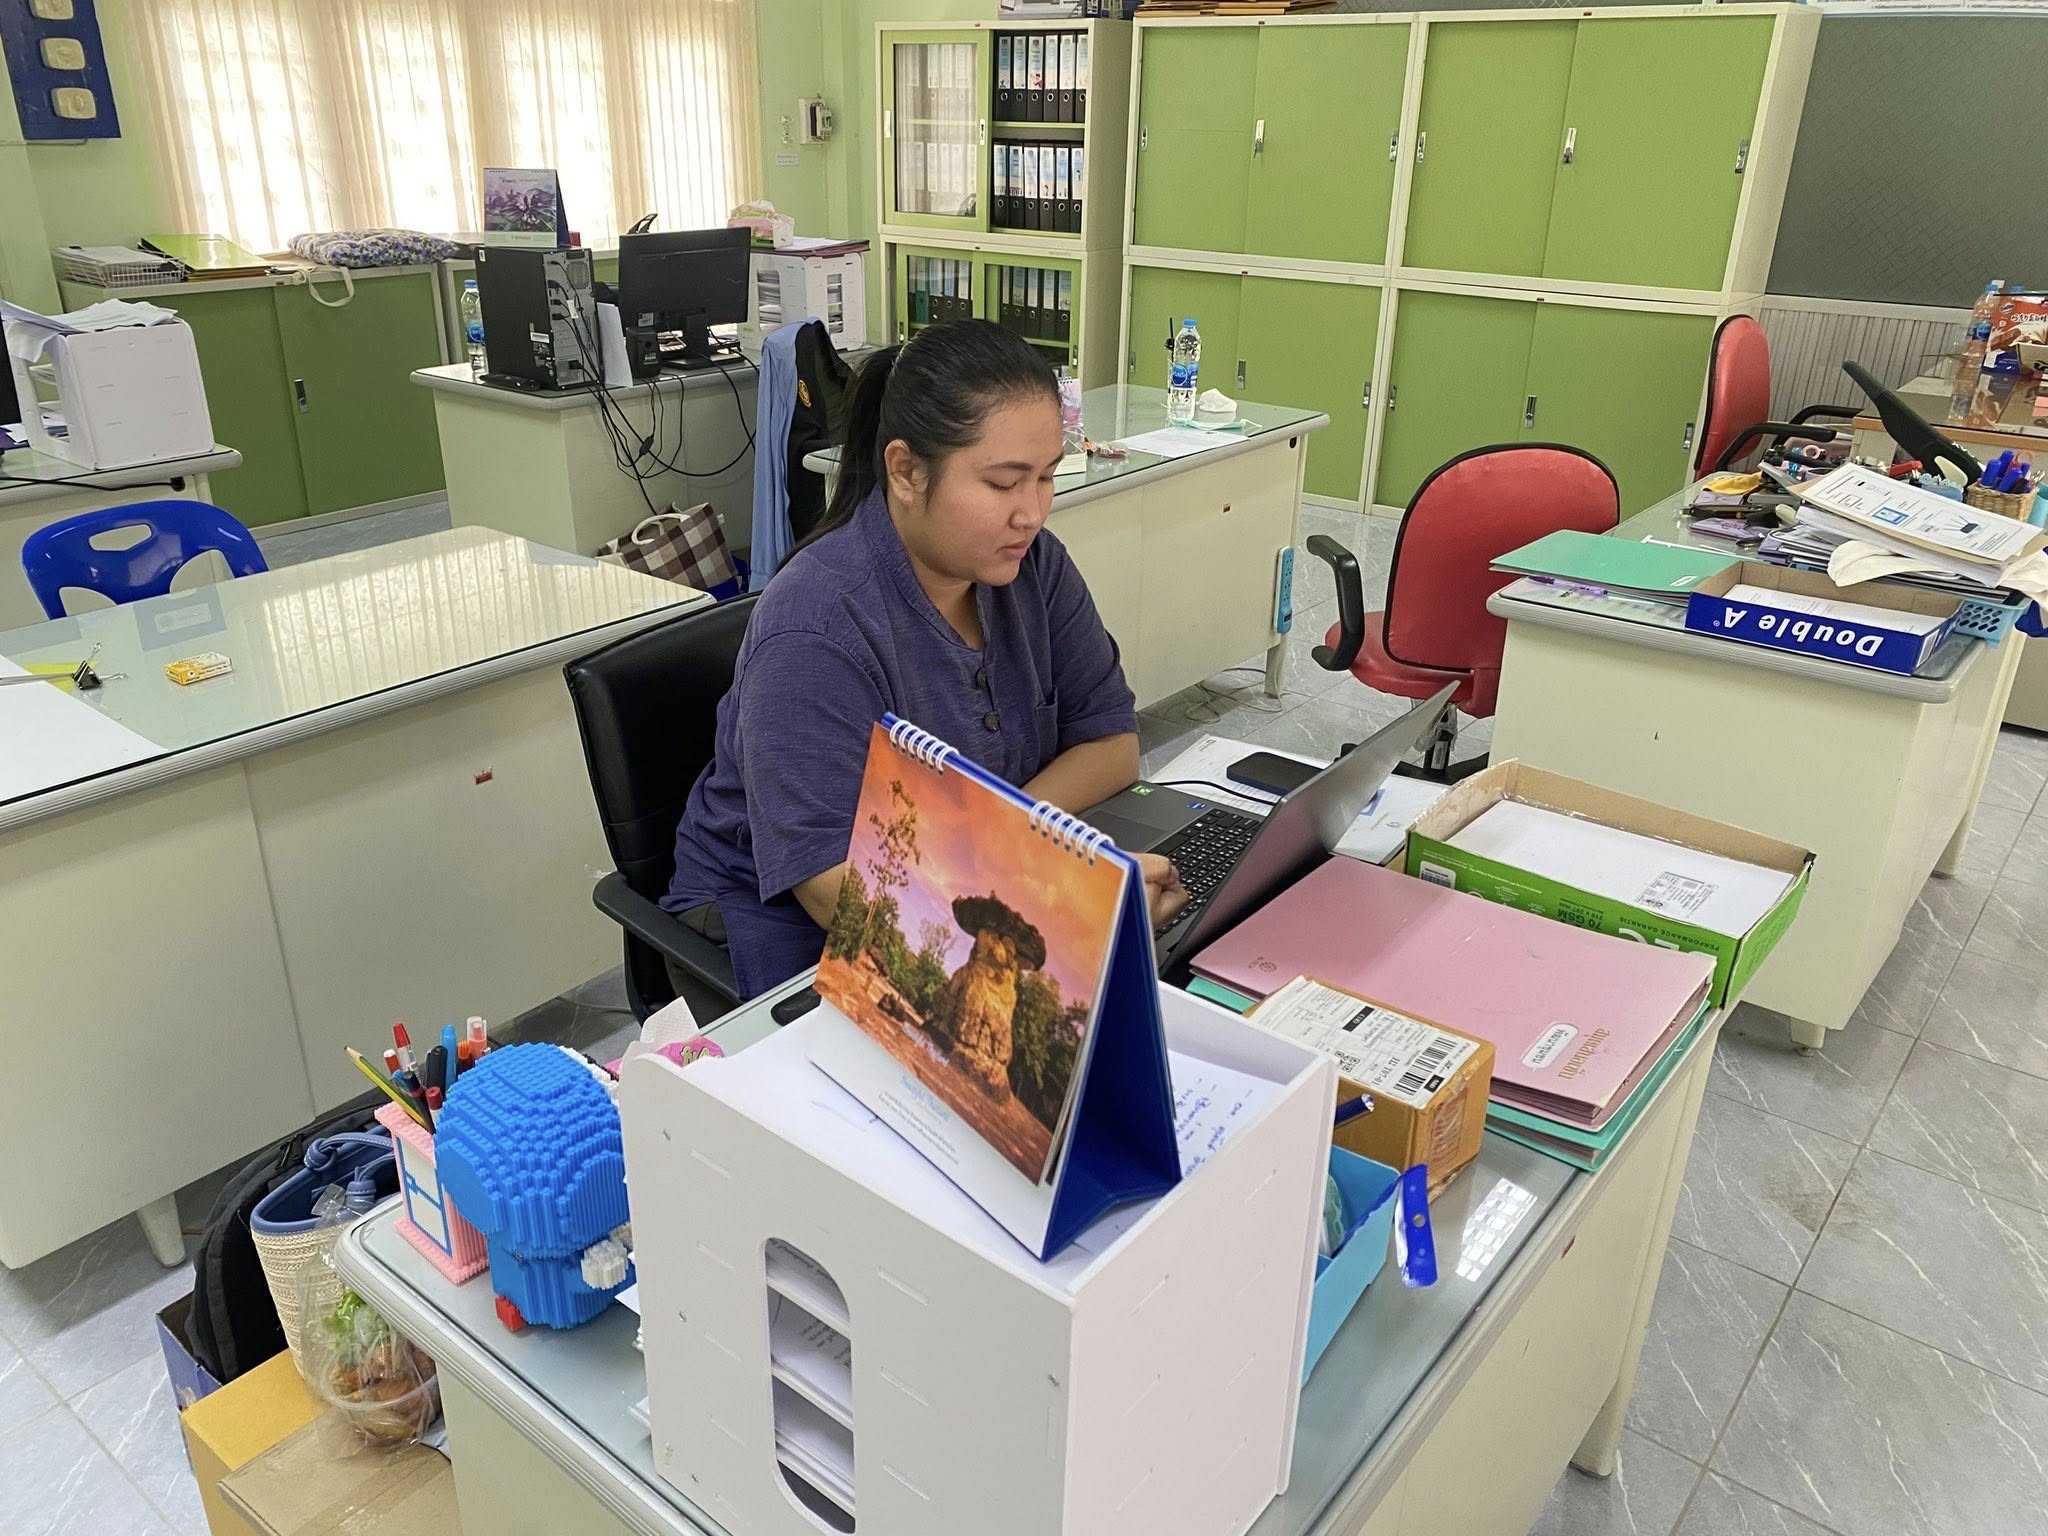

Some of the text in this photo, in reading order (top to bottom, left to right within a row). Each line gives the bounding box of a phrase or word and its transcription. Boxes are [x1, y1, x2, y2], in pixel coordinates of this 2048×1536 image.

[1758, 614, 1884, 657] Double
[1558, 908, 1602, 930] 70 GSM
[1660, 929, 1720, 951] PERFORMANCE
